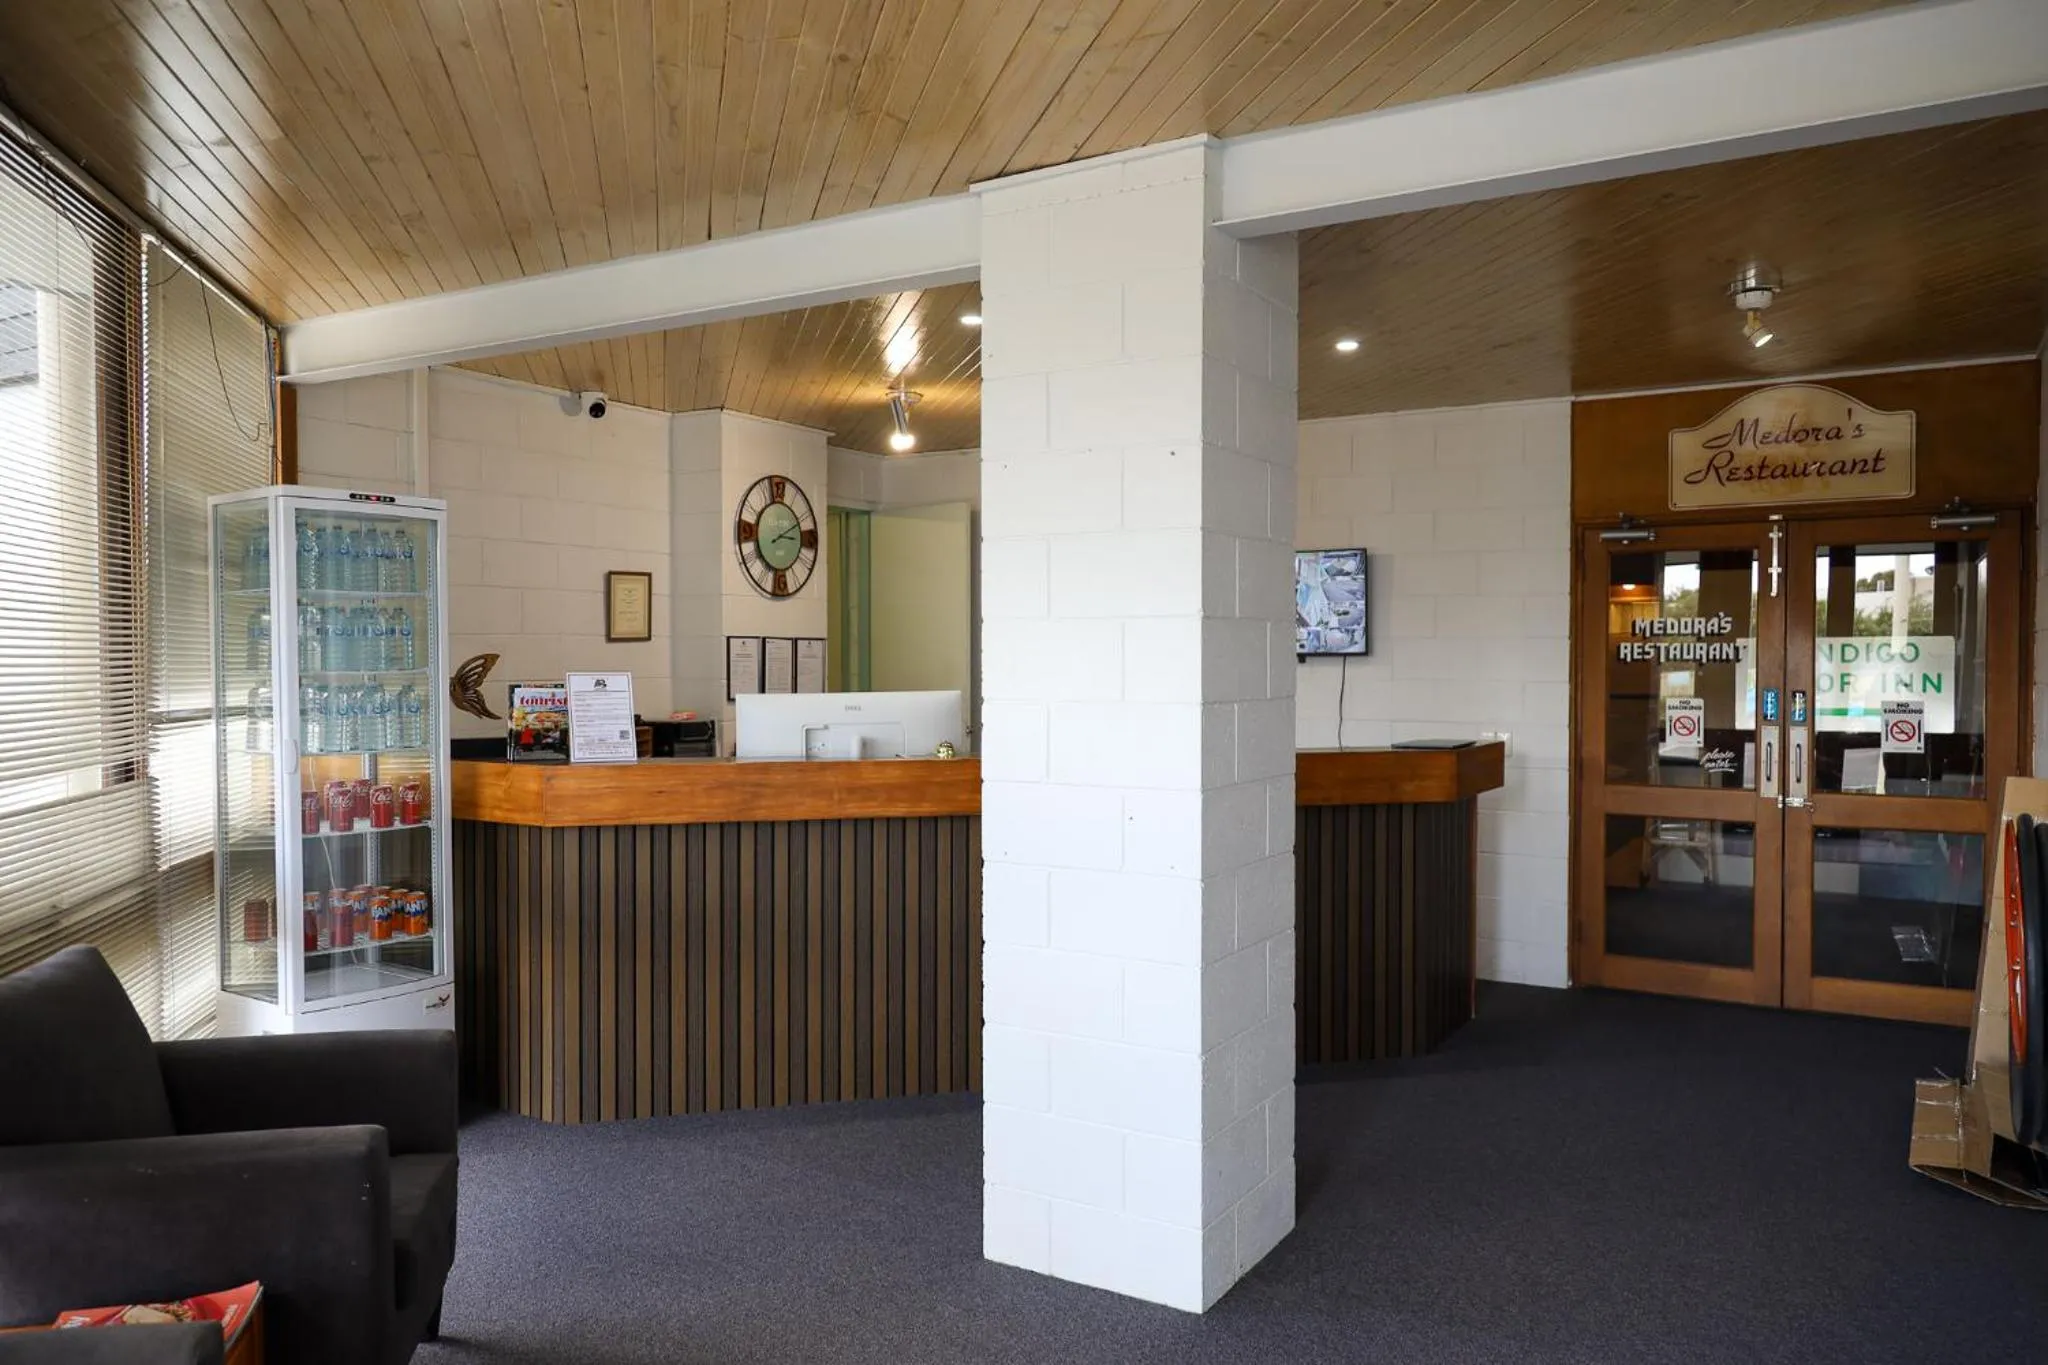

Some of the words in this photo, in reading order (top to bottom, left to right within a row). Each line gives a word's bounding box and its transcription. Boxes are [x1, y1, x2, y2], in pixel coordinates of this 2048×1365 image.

[1702, 408, 1866, 449] Medora's
[1683, 448, 1887, 487] Restaurant
[1633, 612, 1733, 638] MEDORA'S
[1618, 642, 1747, 664] RESTAURANT
[1816, 642, 1920, 663] NDIGO
[1816, 672, 1857, 694] OR
[1881, 672, 1942, 694] INN
